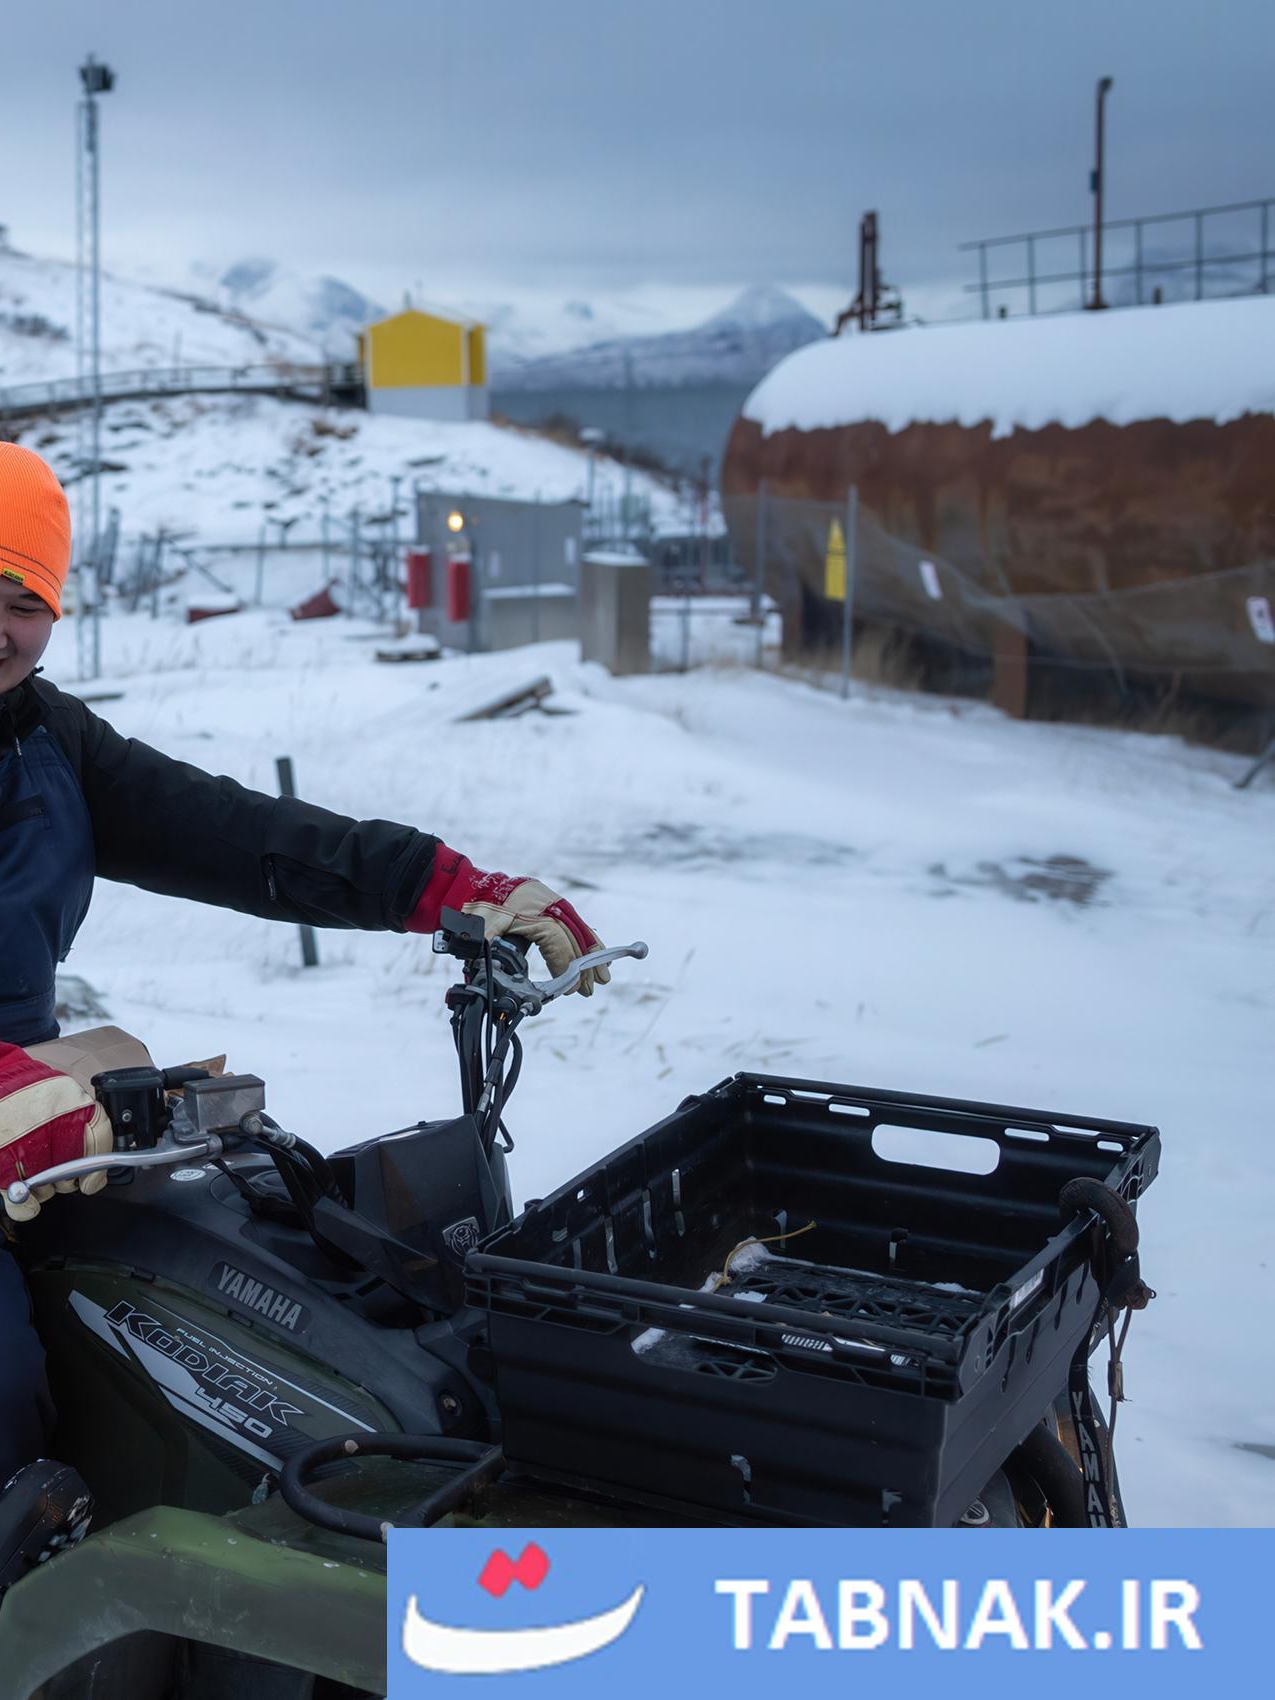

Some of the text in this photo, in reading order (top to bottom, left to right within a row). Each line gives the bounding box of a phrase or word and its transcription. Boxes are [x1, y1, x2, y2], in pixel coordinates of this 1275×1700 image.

[217, 1264, 302, 1330] YAMAHA
[103, 1300, 304, 1426] KODIAK
[176, 1328, 273, 1385] FUEL INJECTION
[195, 1387, 273, 1438] 450
